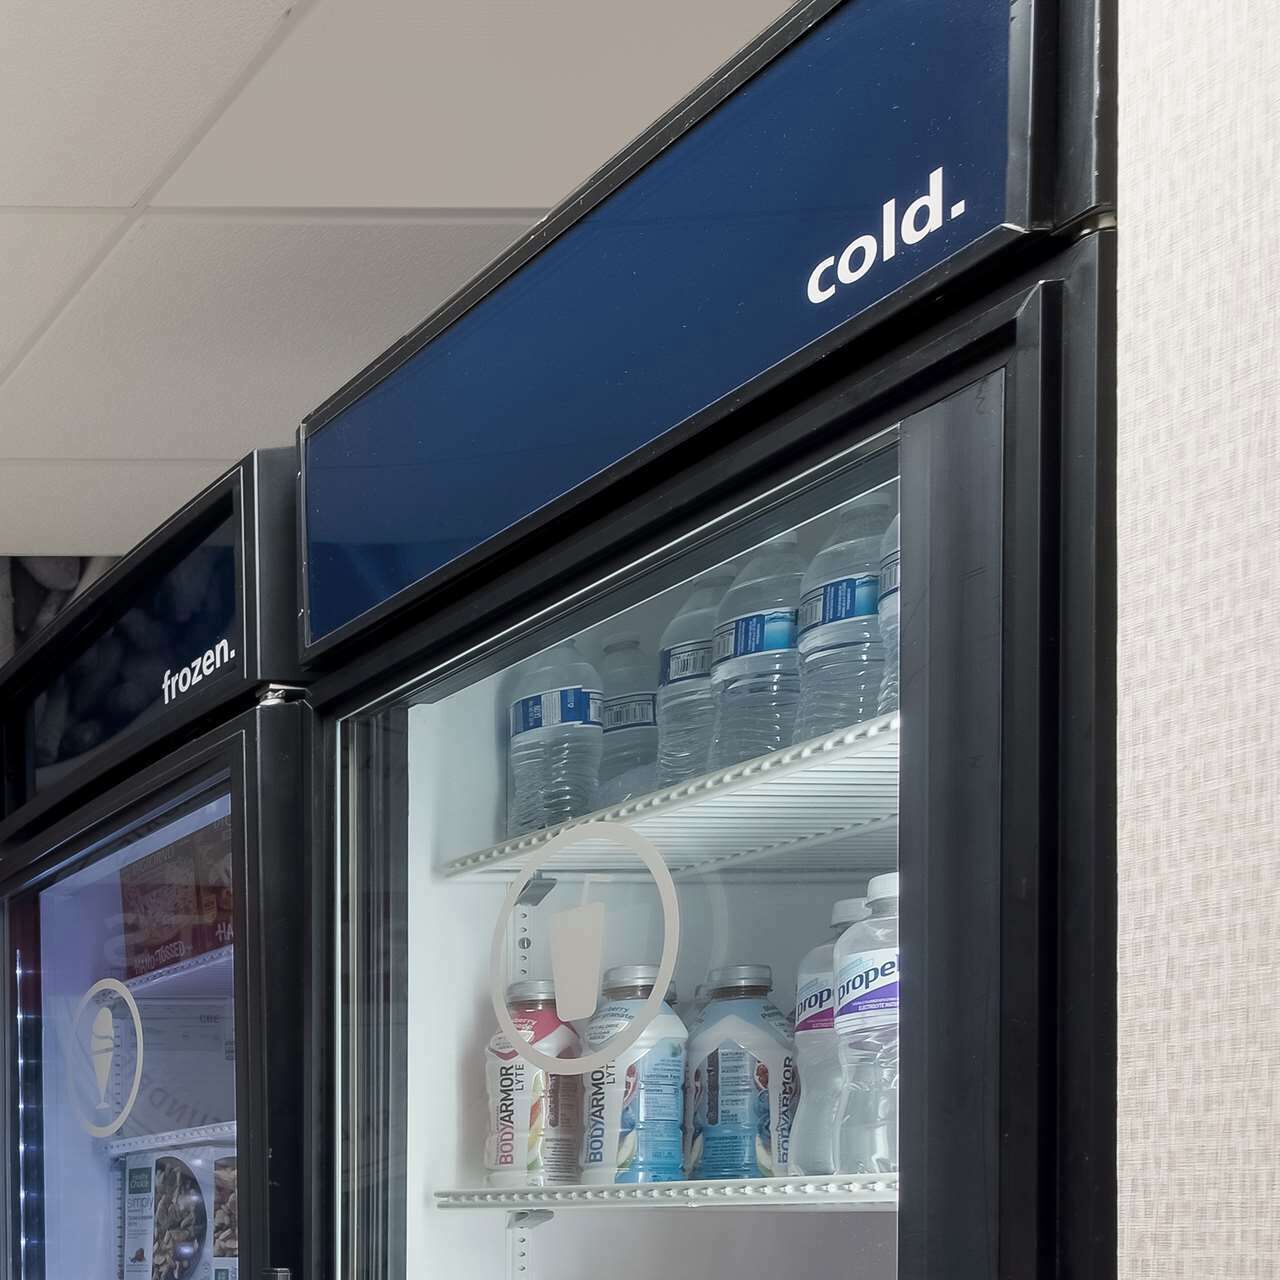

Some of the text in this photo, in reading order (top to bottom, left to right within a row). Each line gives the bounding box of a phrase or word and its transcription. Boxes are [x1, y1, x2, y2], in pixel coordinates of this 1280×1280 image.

[807, 166, 965, 304] cold.
[162, 636, 237, 704] frozen.
[515, 1063, 525, 1092] LYTE
[605, 1059, 616, 1085] LYT
[499, 1064, 514, 1166] BODYARMOR
[589, 1065, 606, 1164] BODYARMO
